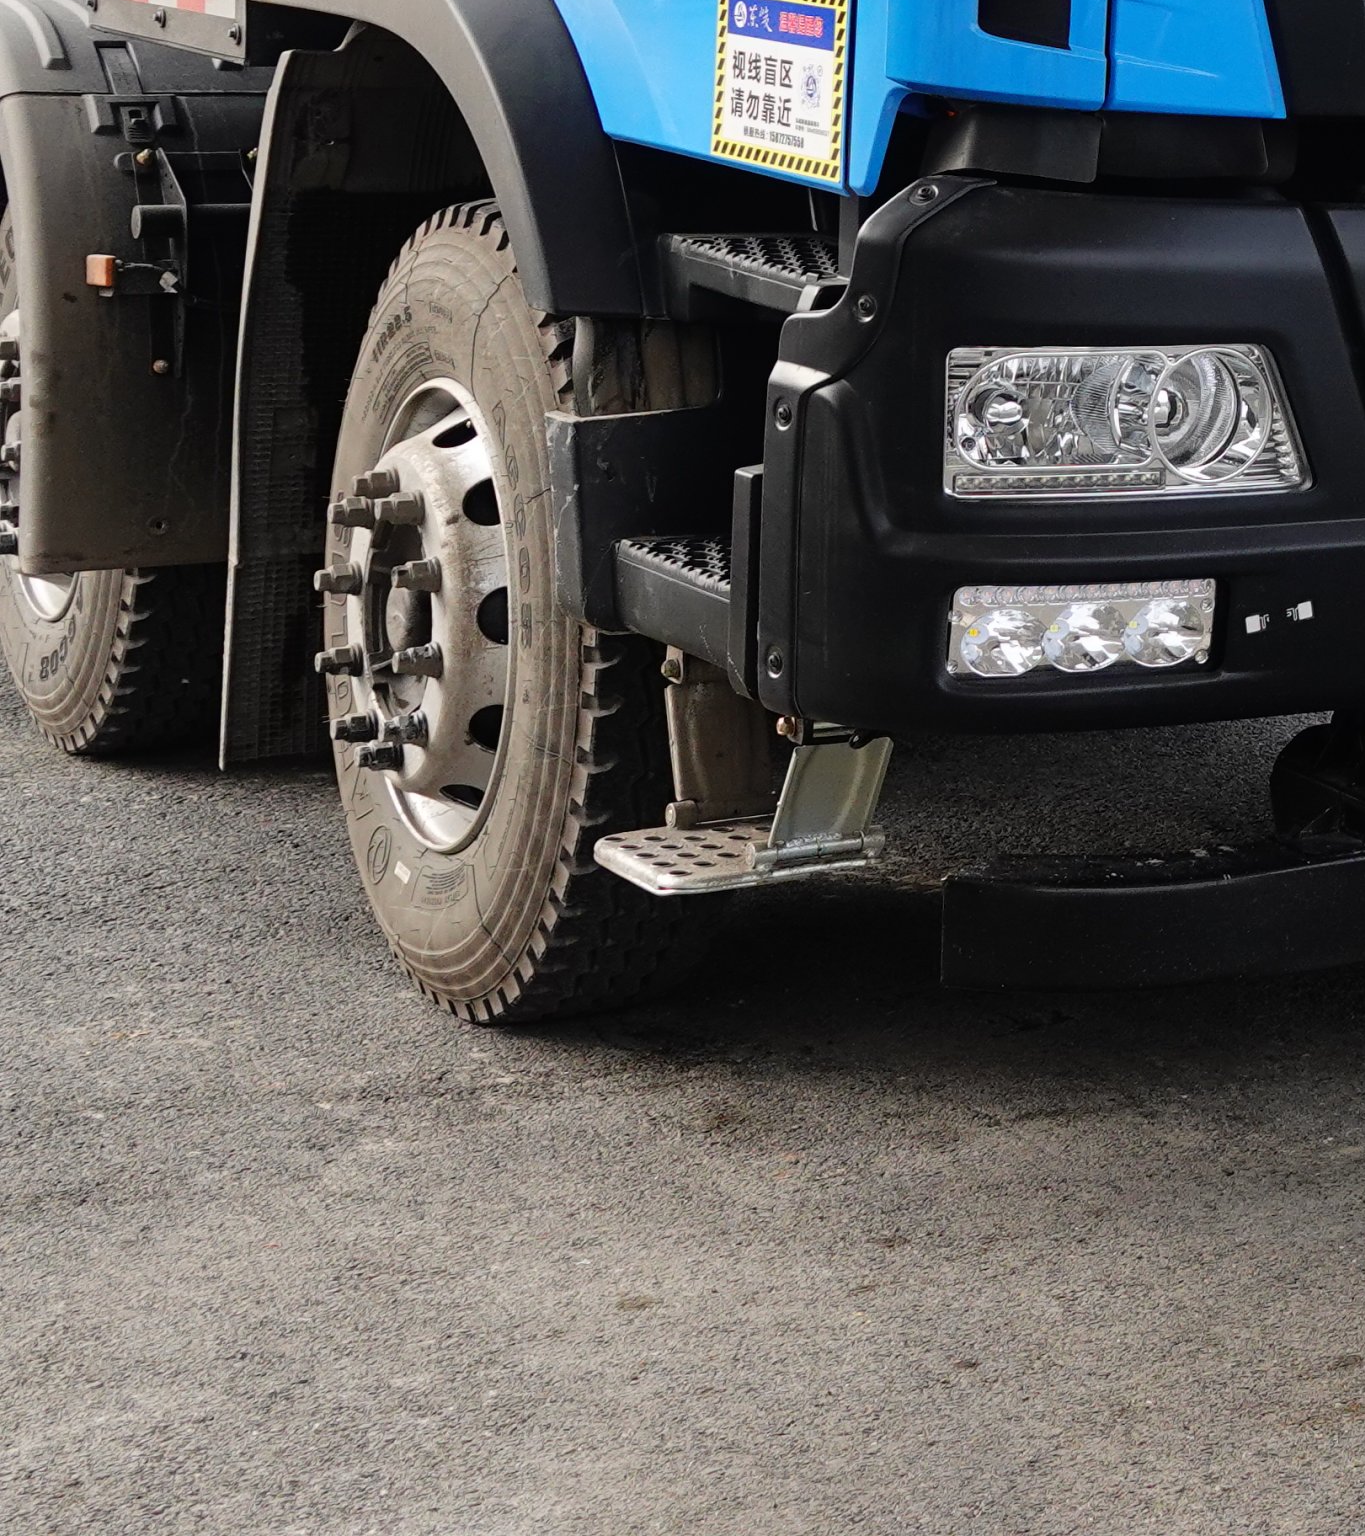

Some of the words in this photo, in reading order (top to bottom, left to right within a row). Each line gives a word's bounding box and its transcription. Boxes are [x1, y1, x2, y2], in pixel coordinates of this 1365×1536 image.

[732, 49, 794, 89] 视线盲区
[730, 87, 792, 128] 请勿靠近
